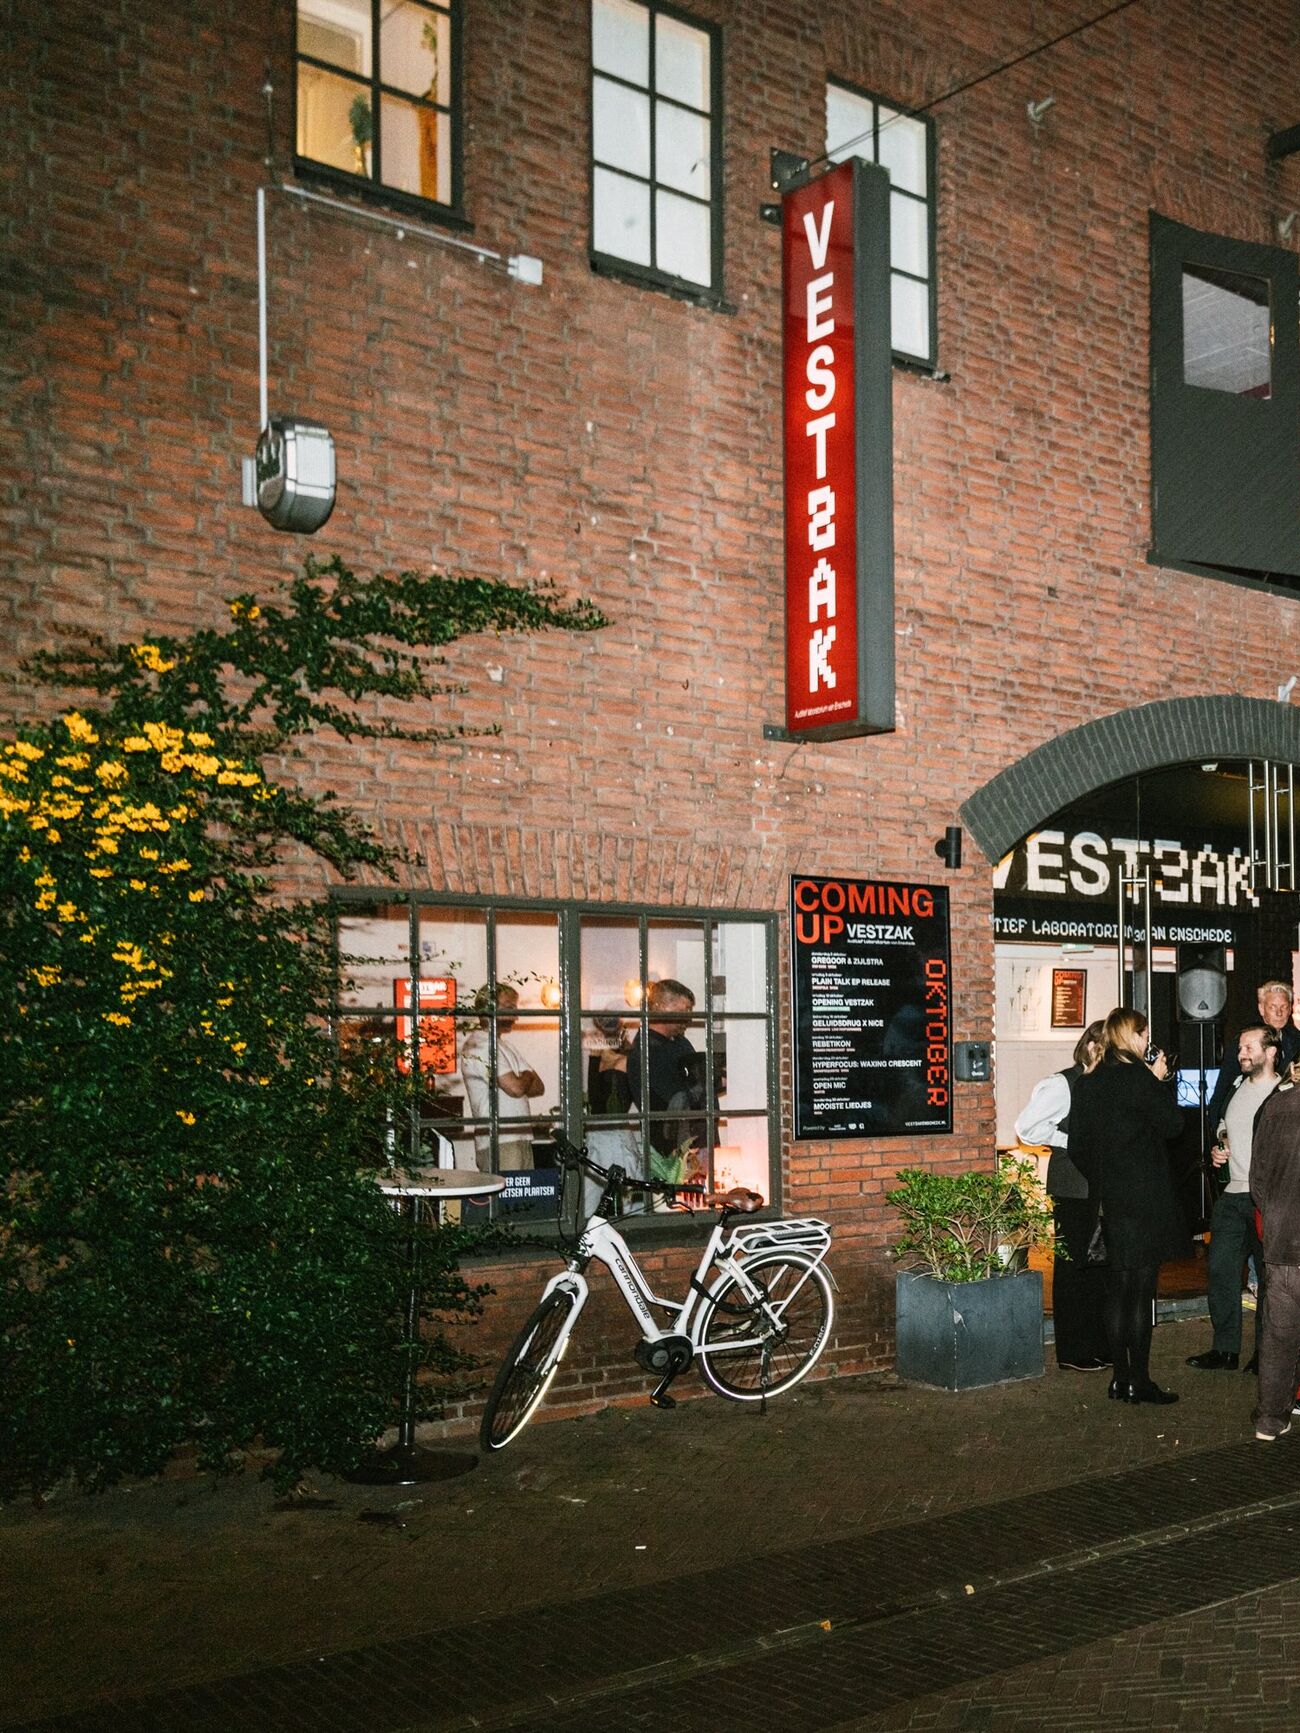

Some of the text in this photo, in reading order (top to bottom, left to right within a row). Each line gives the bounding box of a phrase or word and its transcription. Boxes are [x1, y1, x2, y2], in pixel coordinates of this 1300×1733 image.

[803, 200, 836, 693] VESTZAK
[795, 880, 934, 917] COMING
[796, 913, 844, 944] UP
[847, 923, 914, 940] VESTZAK
[989, 914, 1232, 943] TIEF LABORATORI AN ENSCHEDE
[812, 998, 843, 1006] OPENING
[925, 959, 948, 1106] OKTOBER
[506, 1176, 530, 1187] ER GEEN
[524, 1186, 554, 1197] PLAATSEN
[615, 1258, 650, 1319] cannondale
